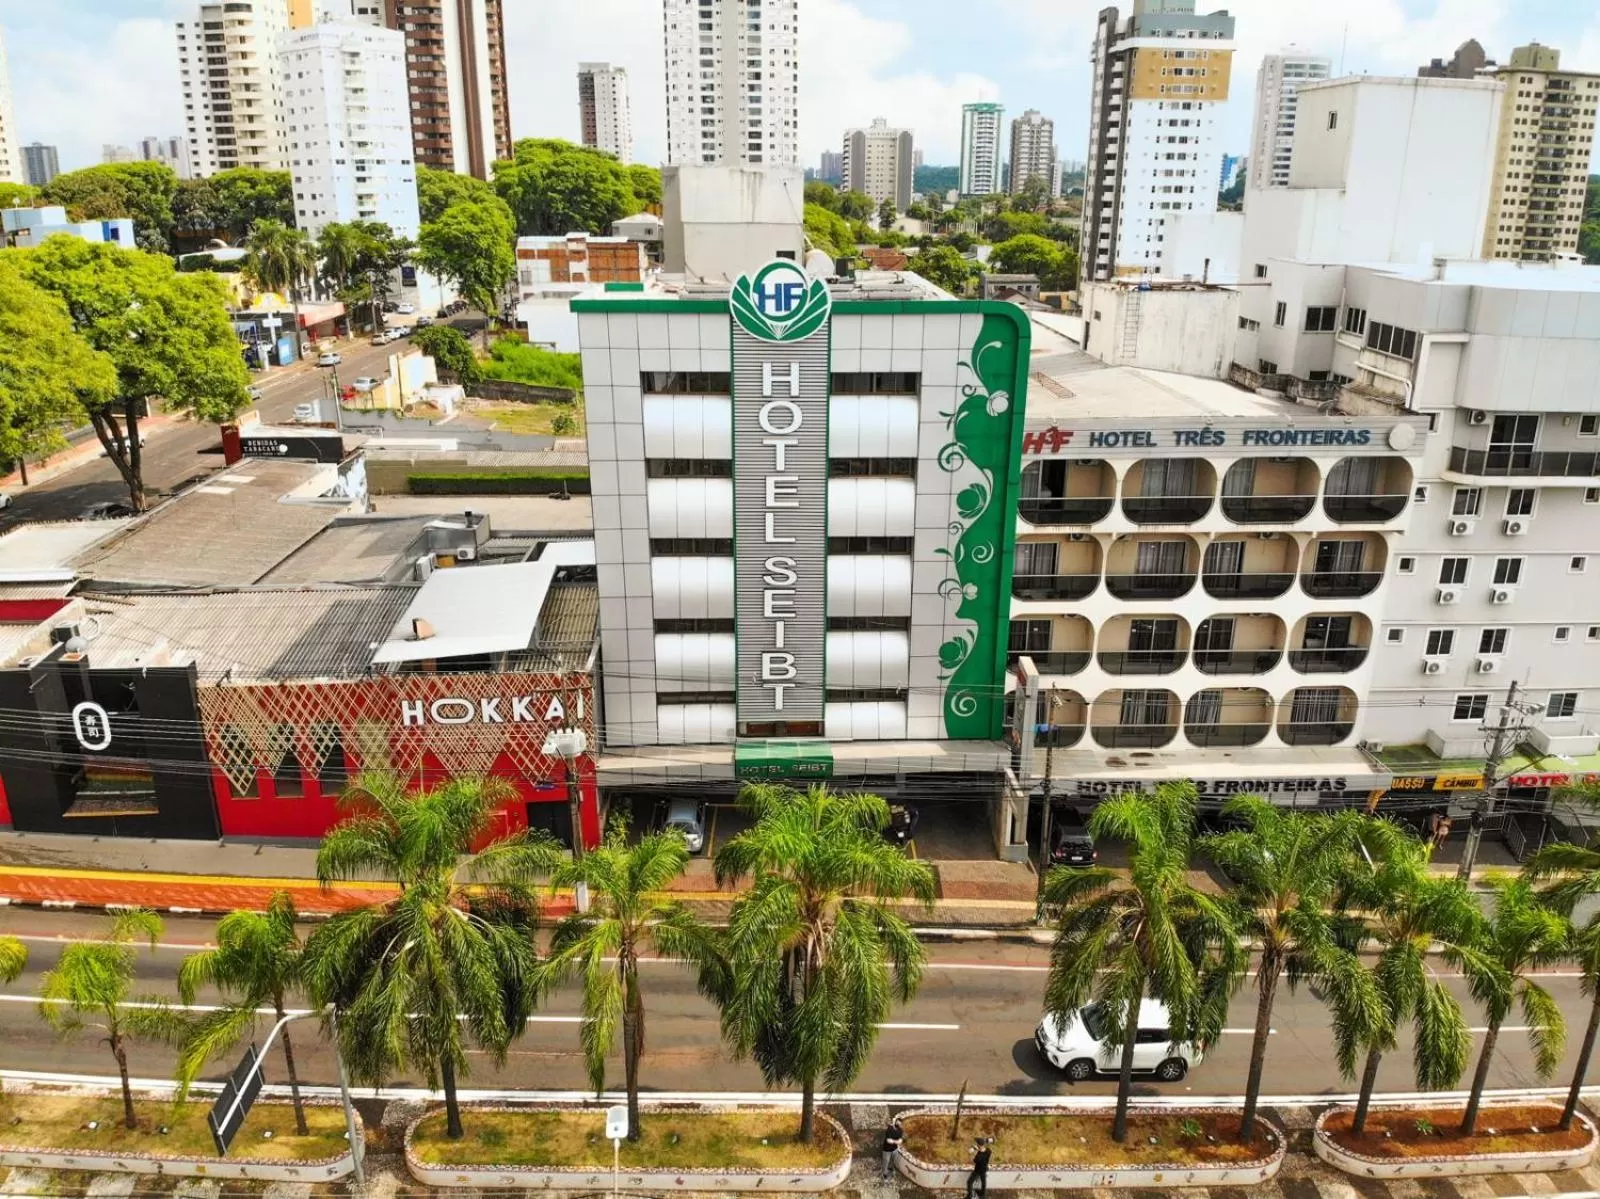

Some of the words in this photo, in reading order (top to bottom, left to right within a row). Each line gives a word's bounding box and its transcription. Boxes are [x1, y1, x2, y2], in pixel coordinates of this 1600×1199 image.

[758, 283, 804, 313] HF
[1089, 431, 1157, 447] HOTEL
[1173, 427, 1226, 446] TRÊS
[1242, 429, 1371, 446] FRONTEIRAS
[758, 361, 803, 543] HOTEL
[761, 556, 798, 711] SEIBT
[739, 765, 785, 774] HOTEL
[1213, 777, 1347, 793] FRONTEIRAS
